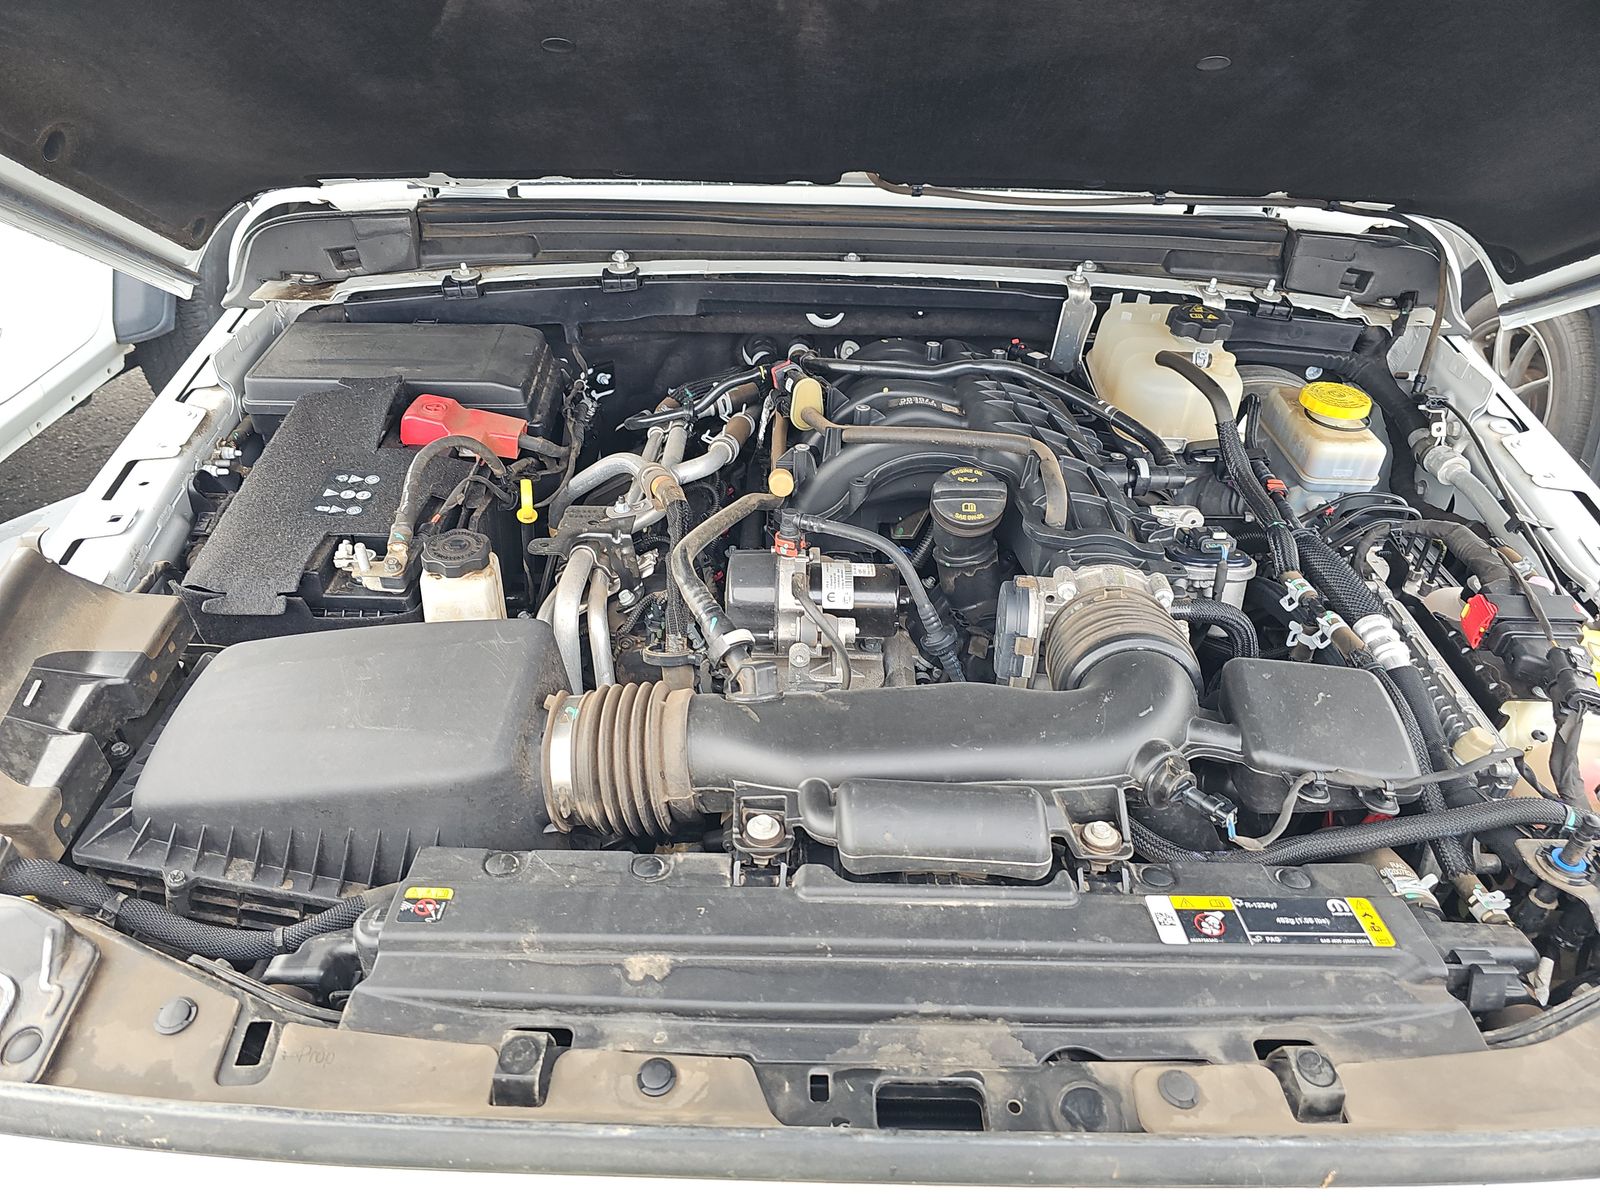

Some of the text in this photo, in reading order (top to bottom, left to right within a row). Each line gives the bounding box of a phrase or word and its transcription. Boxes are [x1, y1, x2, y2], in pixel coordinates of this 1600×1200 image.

[951, 467, 984, 477] ENGINE OIL
[954, 512, 967, 521] SAE
